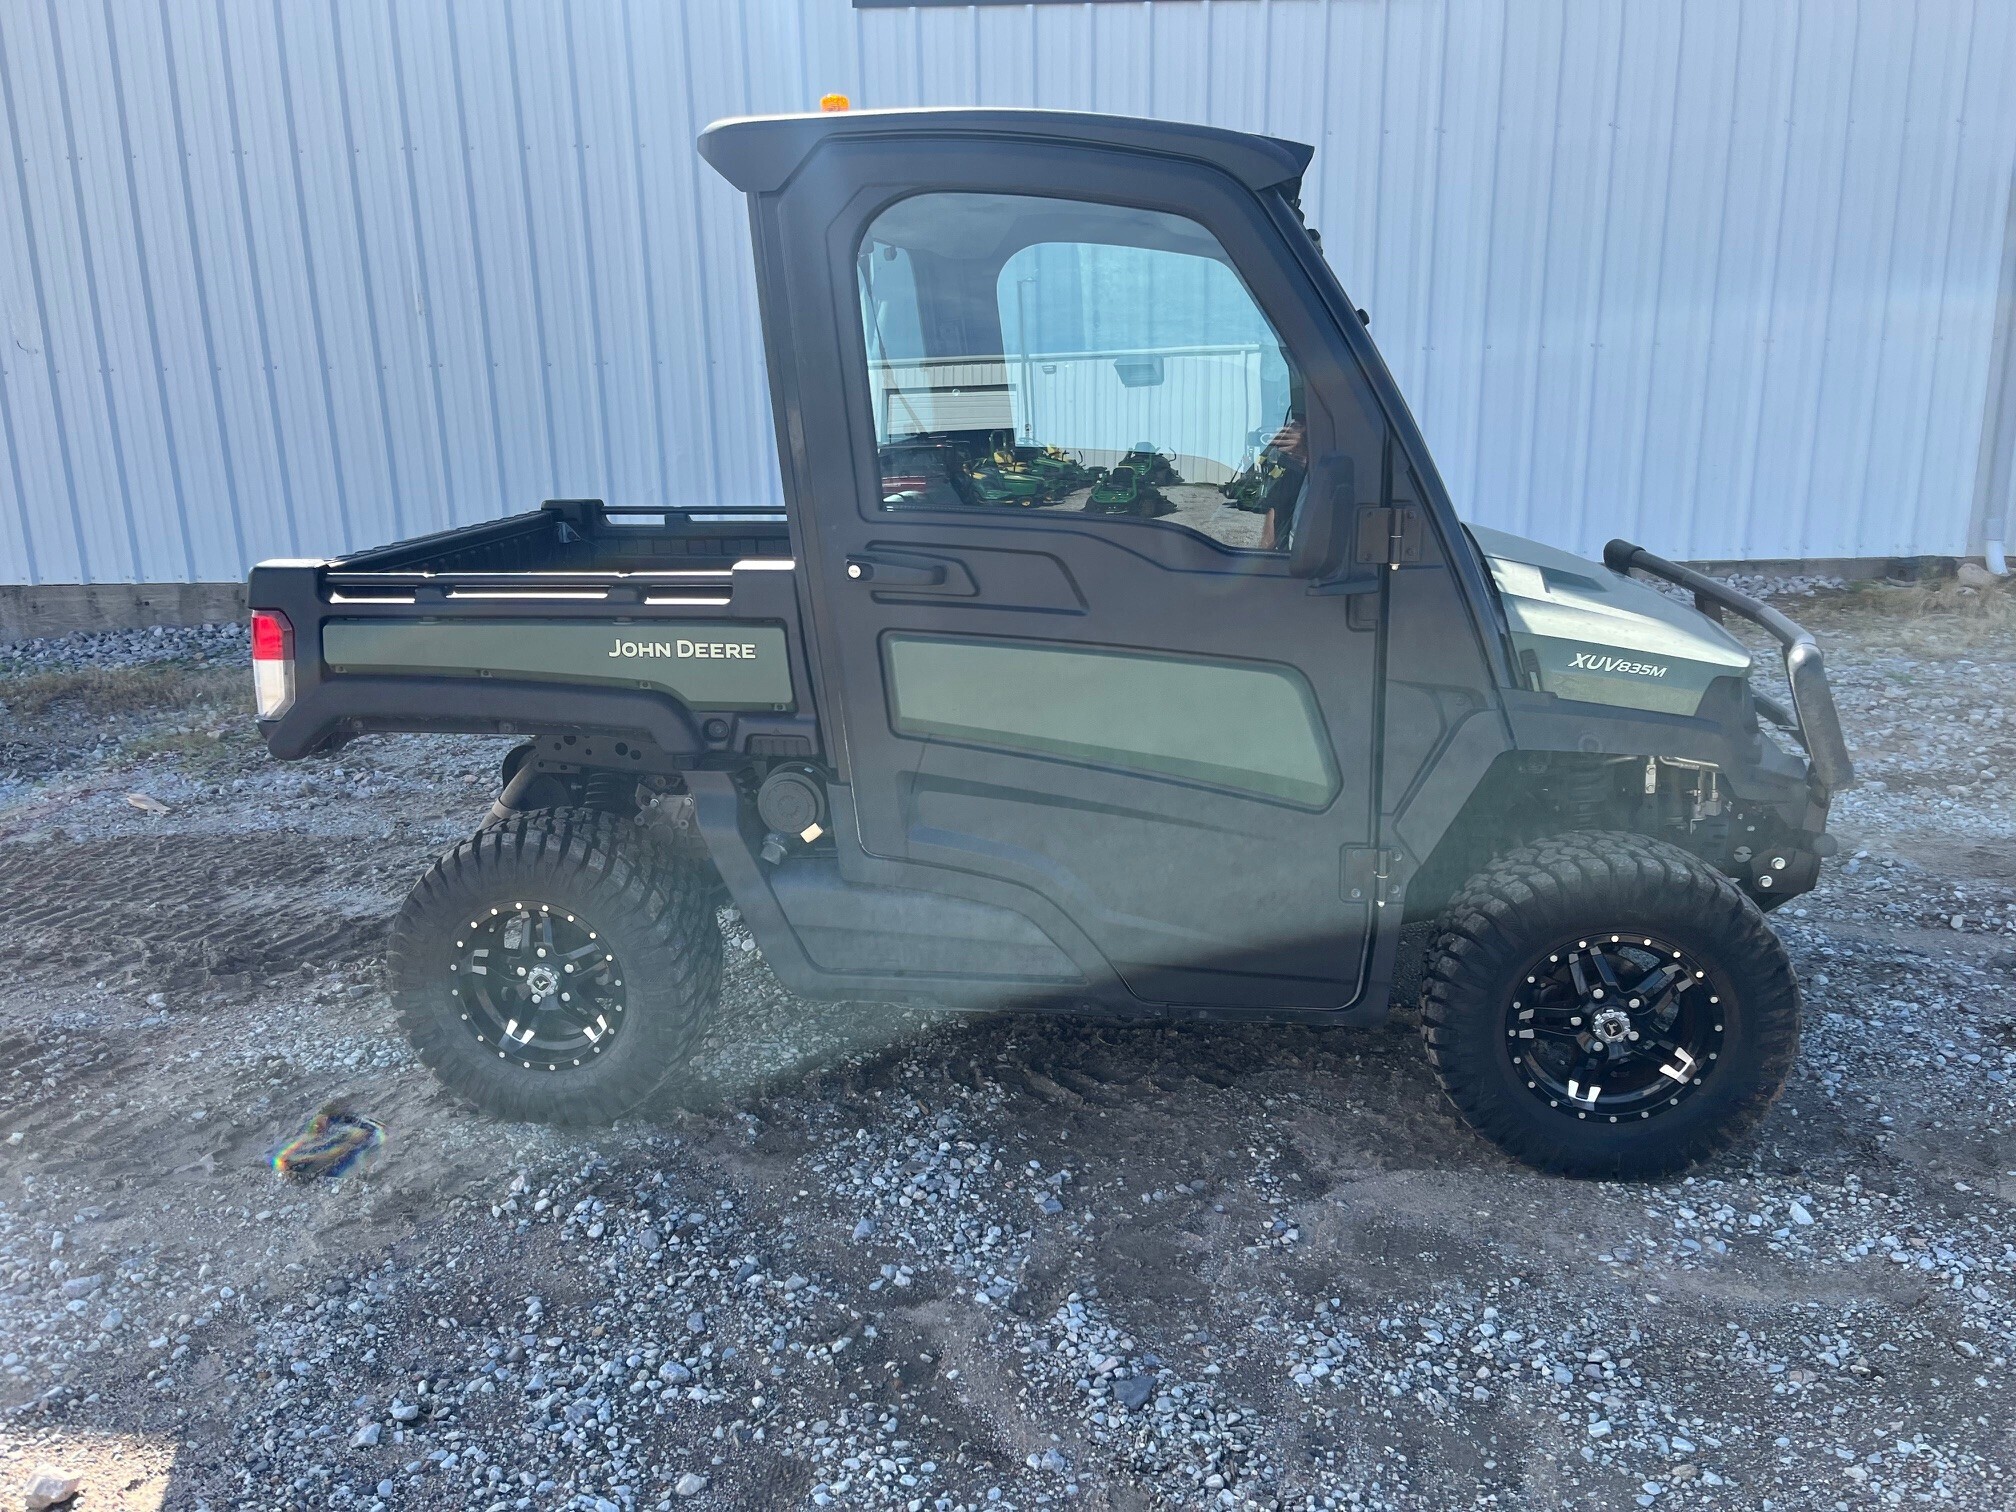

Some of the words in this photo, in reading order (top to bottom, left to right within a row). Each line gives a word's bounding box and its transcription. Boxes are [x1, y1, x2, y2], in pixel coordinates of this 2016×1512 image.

[608, 639, 671, 658] JOHN
[676, 640, 756, 659] DEERE
[1568, 653, 1667, 678] XUV835M
